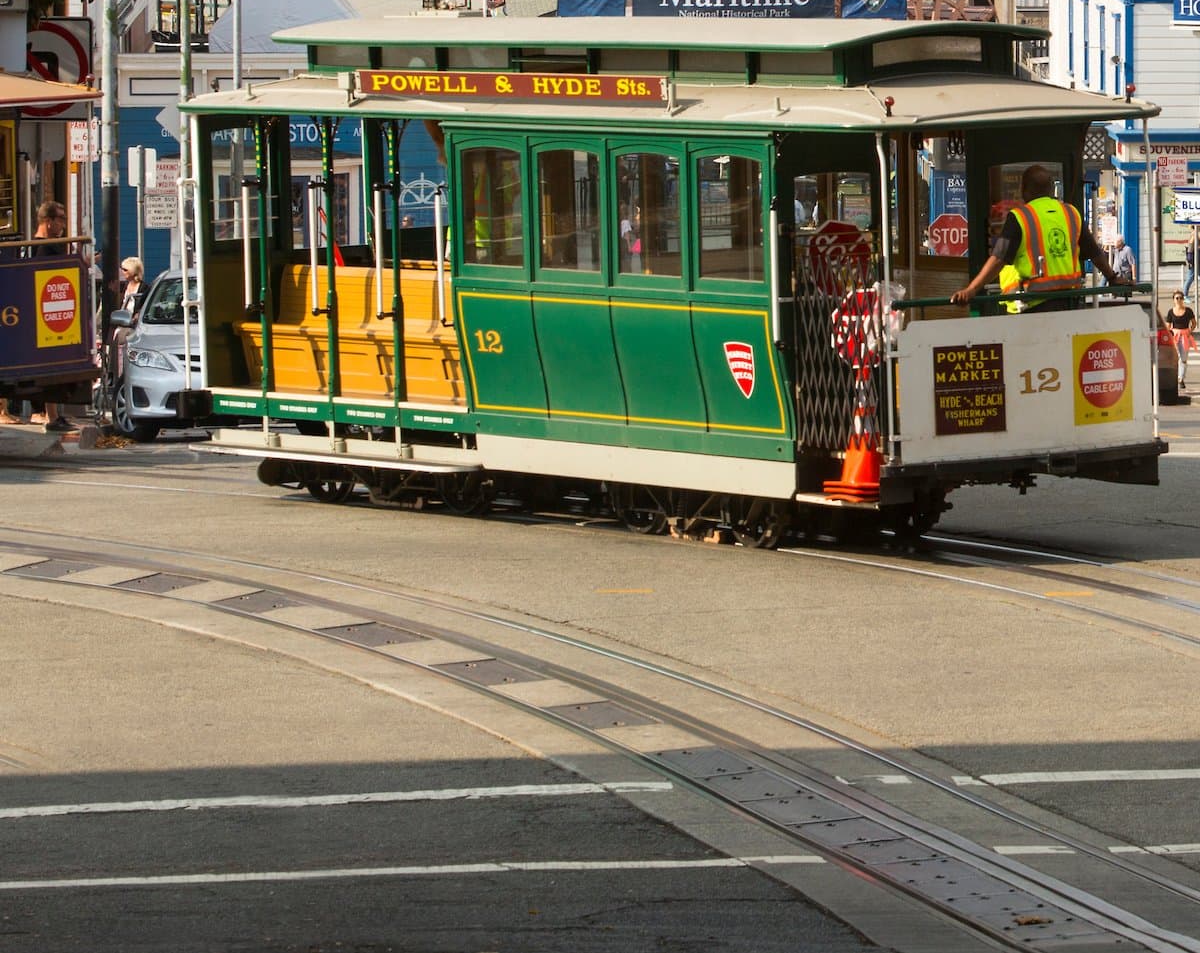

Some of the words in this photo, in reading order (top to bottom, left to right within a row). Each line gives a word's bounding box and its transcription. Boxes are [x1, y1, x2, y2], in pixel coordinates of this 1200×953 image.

[679, 9, 719, 18] National
[721, 9, 767, 18] Historical
[769, 8, 791, 17] Park
[371, 74, 477, 93] POWELL
[495, 75, 513, 93] &
[533, 77, 602, 96] HYDE
[616, 78, 651, 96] Sts.
[932, 228, 968, 245] STOP
[47, 284, 57, 293] DO
[57, 283, 70, 291] NOT
[50, 291, 67, 300] PASS
[44, 312, 62, 321] CABLE
[62, 311, 74, 320] CAR
[474, 329, 503, 353] 12
[937, 349, 1000, 363] POWELL
[1088, 350, 1100, 360] DO
[1101, 348, 1118, 358] NOT
[954, 361, 984, 370] AND
[1093, 358, 1114, 368] PASS
[935, 369, 1000, 383] MARKET
[1019, 367, 1061, 395] 12
[1084, 384, 1108, 394] CABLE
[1108, 382, 1123, 392] CAR
[940, 395, 962, 409] HYDE
[975, 393, 1003, 407] BEACH
[945, 407, 998, 420] FISHERMANS
[957, 417, 985, 427] WHARF
